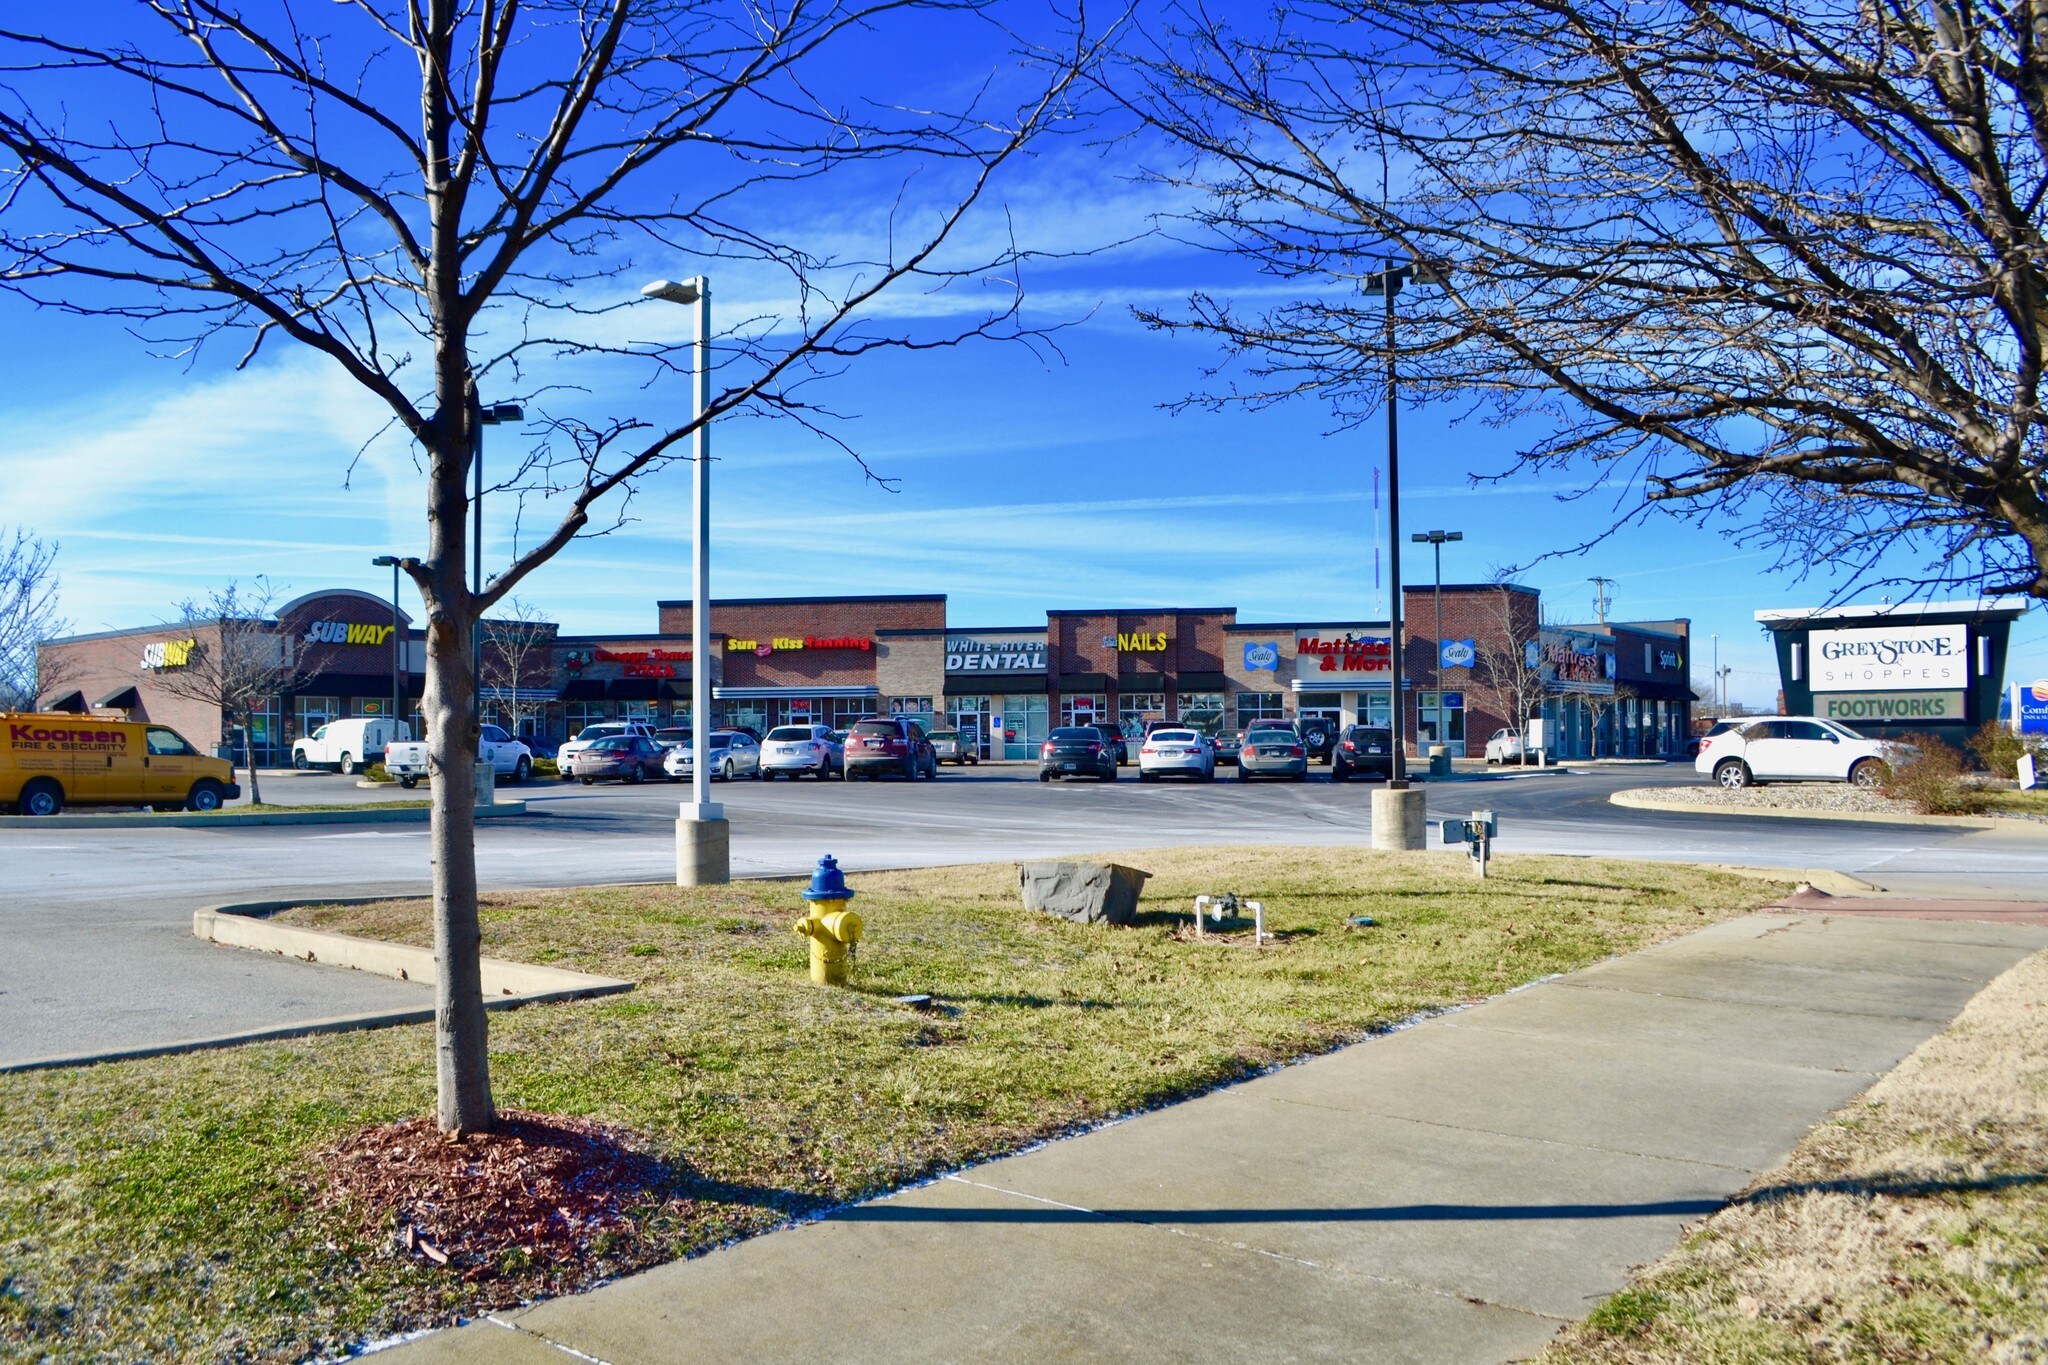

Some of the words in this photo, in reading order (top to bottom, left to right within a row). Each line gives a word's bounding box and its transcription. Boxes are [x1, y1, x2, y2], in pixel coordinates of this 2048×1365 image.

[304, 621, 395, 645] SUBWAY
[728, 639, 757, 650] Sun
[773, 637, 804, 649] Kiss
[805, 637, 870, 650] Tanning
[947, 640, 992, 652] WHITE
[1000, 640, 1044, 651] RIVER
[1118, 632, 1167, 651] NAILS
[140, 637, 198, 669] SUBWAY
[1249, 649, 1273, 663] Sealy
[1446, 646, 1469, 660] Sealy
[1660, 650, 1677, 670] Sprint
[945, 653, 1046, 670] DENTAL
[1319, 655, 1337, 671] &
[1826, 668, 1950, 681] SHOPPES
[1828, 699, 1945, 717] FOOTWORKS
[10, 725, 127, 743] Koorsen
[12, 742, 41, 750] FIRE
[47, 742, 57, 750] &
[61, 742, 126, 751] SECURITY
